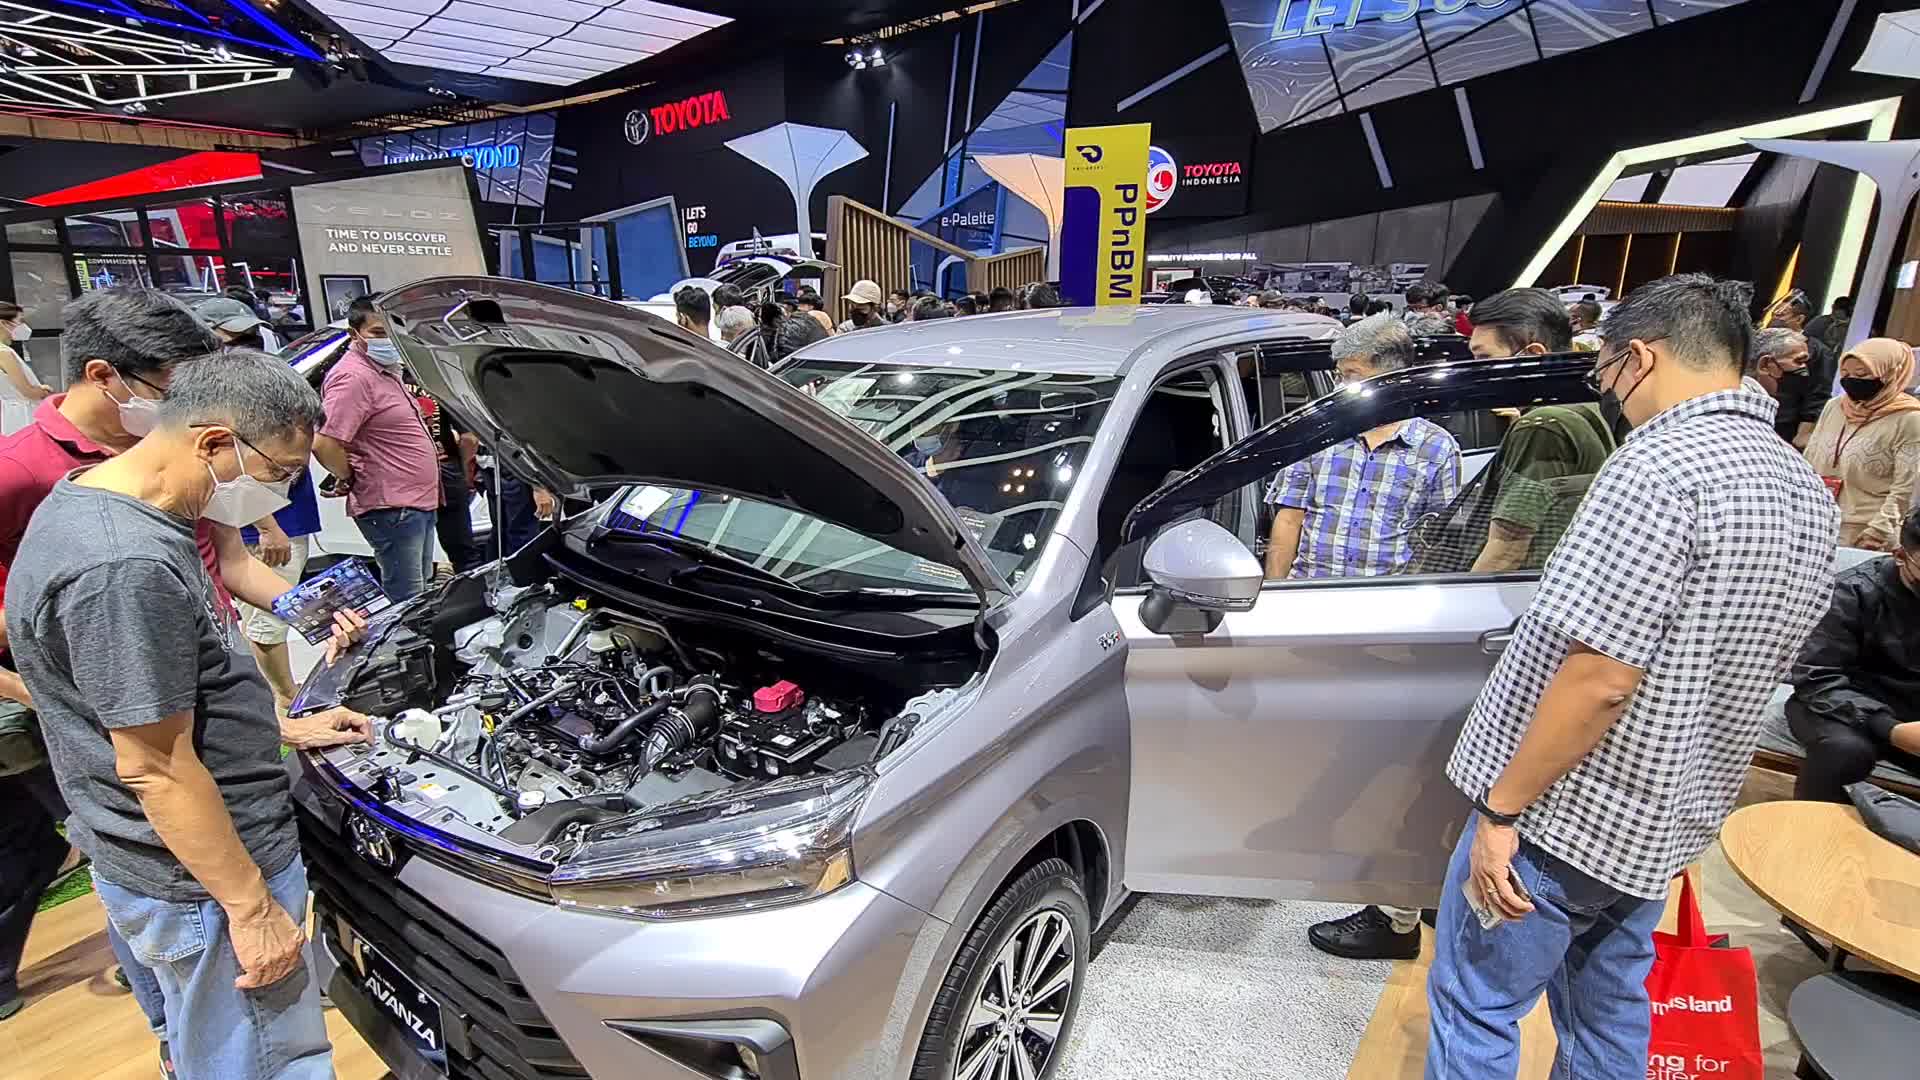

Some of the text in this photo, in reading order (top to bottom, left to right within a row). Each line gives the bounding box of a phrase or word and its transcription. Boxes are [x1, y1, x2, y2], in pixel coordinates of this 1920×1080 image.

[650, 90, 730, 136] TOYOTA
[1184, 162, 1241, 177] TOYOTA
[1182, 176, 1240, 186] INDONESIA
[312, 203, 463, 221] VELOZ
[941, 211, 995, 227] e-Palette
[687, 222, 698, 234] GO
[325, 229, 447, 243] TIME TO DISCOVER
[688, 235, 718, 248] BEYOND
[1109, 183, 1138, 298] PPnBM
[328, 242, 453, 256] AND NEVER SETTLE
[365, 976, 436, 1049] AVANZA
[1694, 1054, 1731, 1072] for
